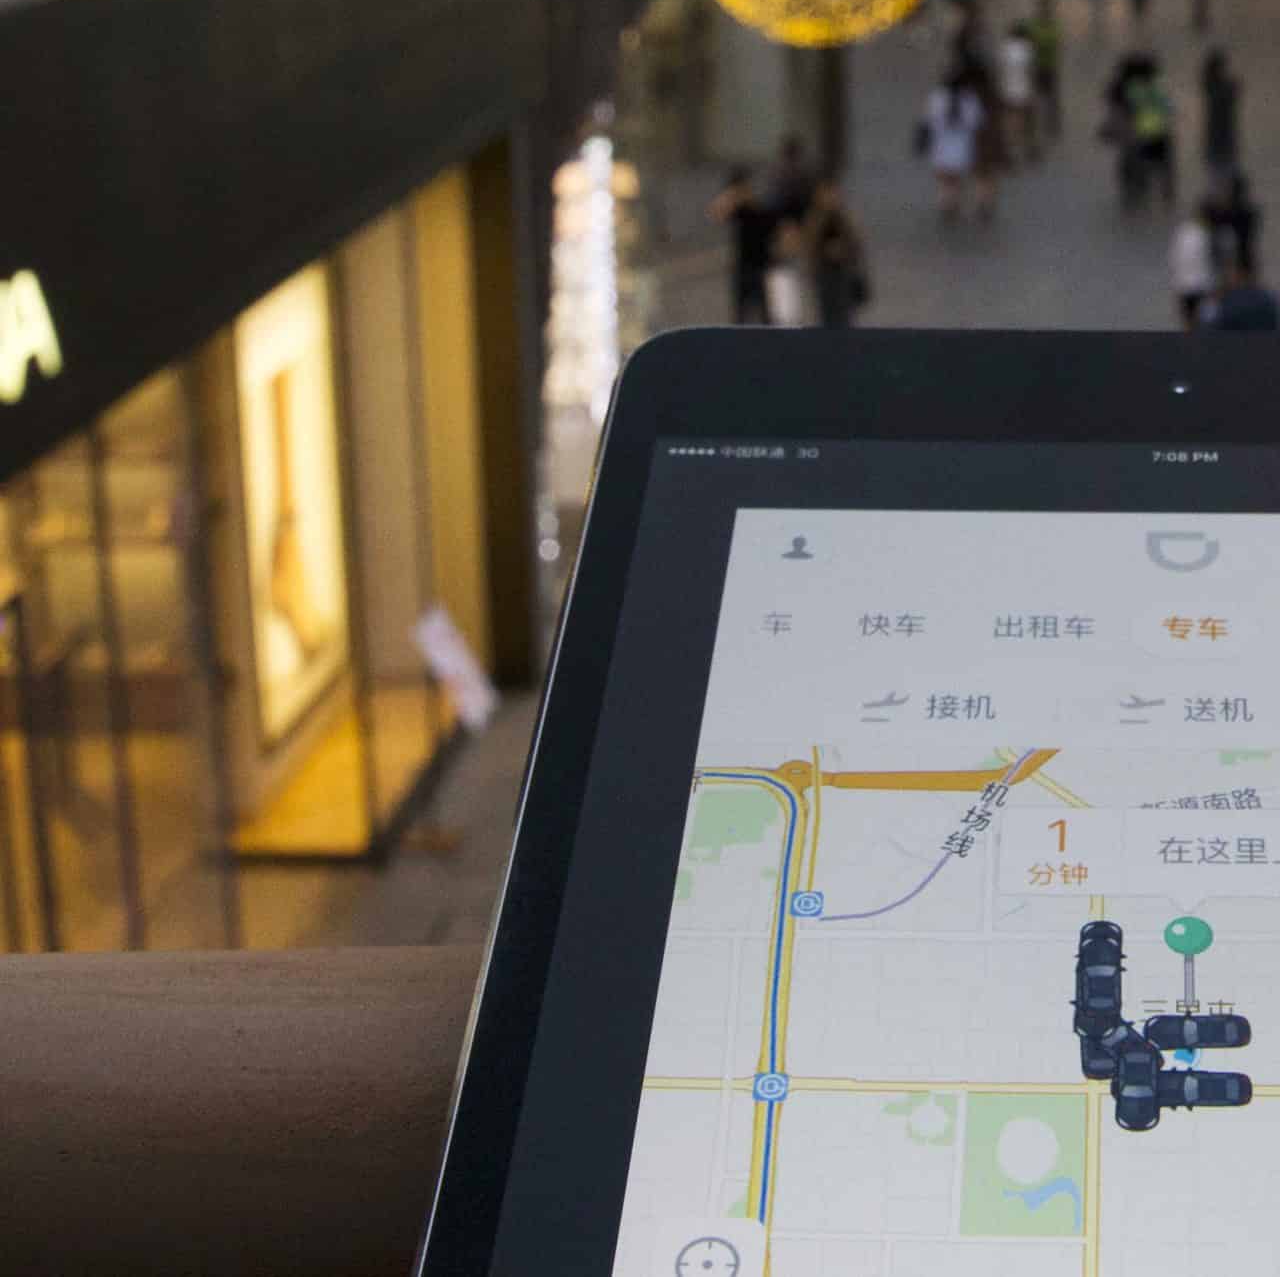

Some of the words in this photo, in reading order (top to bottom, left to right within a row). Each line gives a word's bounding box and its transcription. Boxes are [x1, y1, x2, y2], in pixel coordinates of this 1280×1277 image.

[1192, 450, 1219, 463] PM
[858, 613, 926, 637] 快车
[993, 615, 1095, 639] 出租车
[1162, 616, 1229, 640] 专车
[926, 694, 996, 721] 接机
[1183, 697, 1254, 723] 送机
[940, 781, 1009, 858] 机场线
[1047, 818, 1067, 852] 1
[1027, 861, 1089, 887] 分钟
